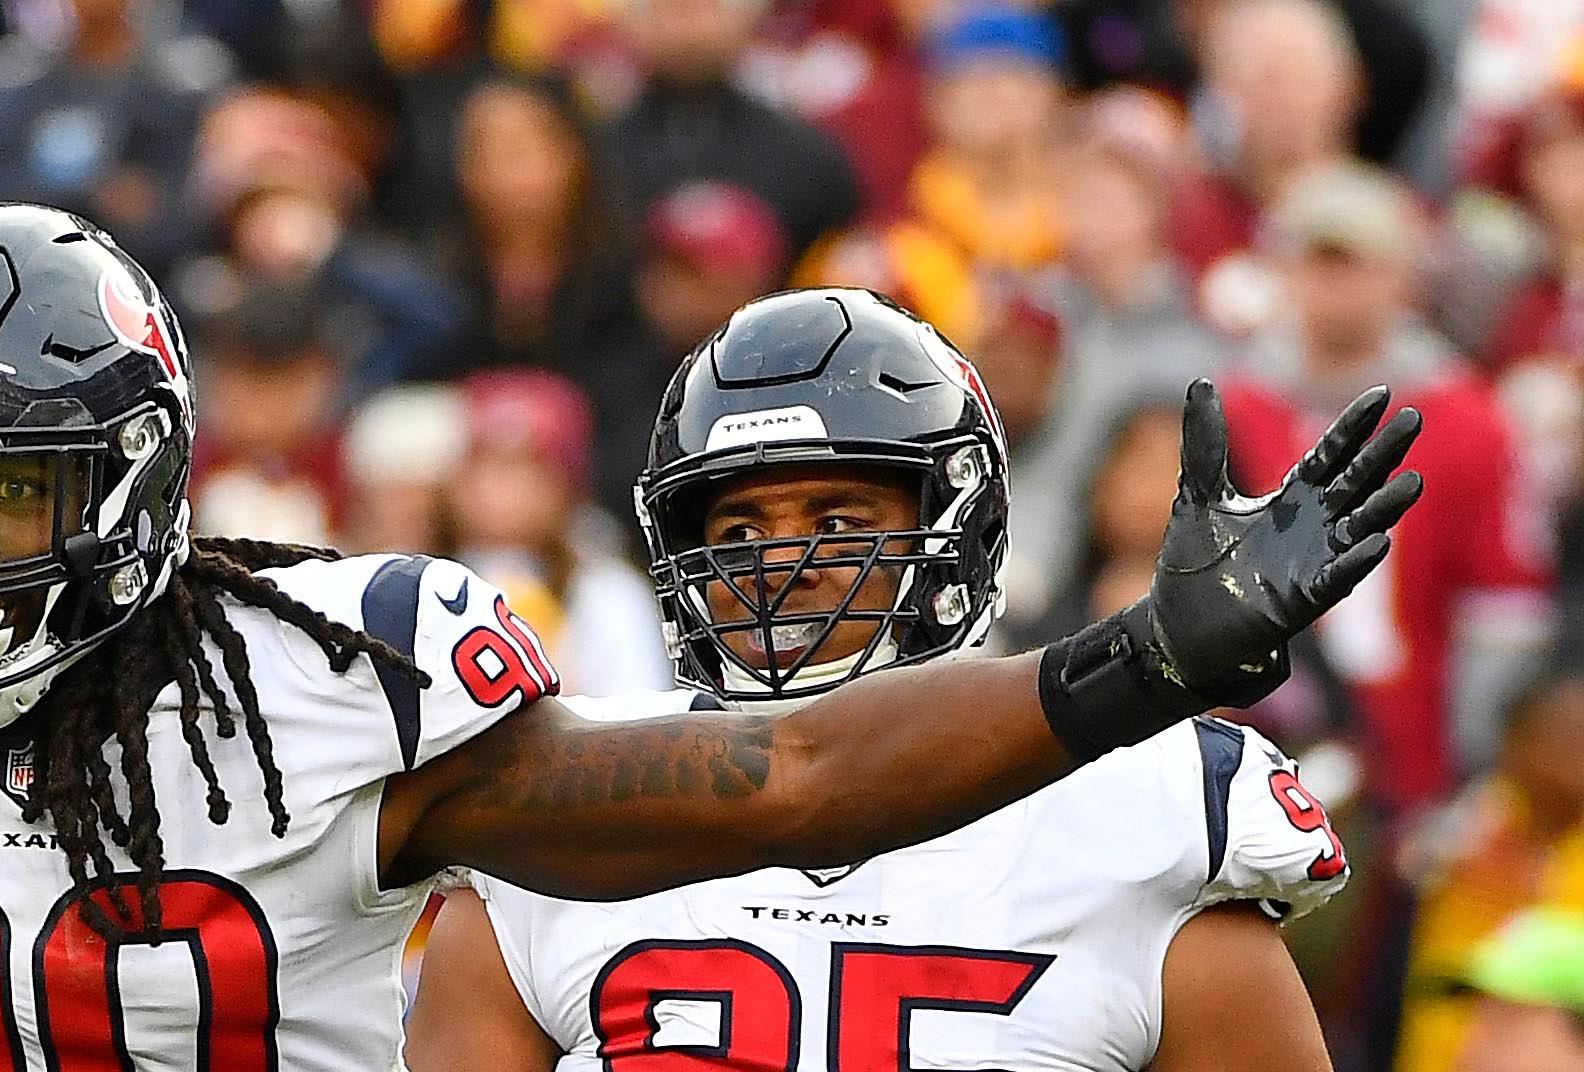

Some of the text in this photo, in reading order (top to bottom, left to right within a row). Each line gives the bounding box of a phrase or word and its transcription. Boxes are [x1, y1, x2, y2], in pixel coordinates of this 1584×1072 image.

[722, 415, 802, 432] TEXANS
[1267, 768, 1348, 881] 9
[741, 906, 891, 927] TEXANS
